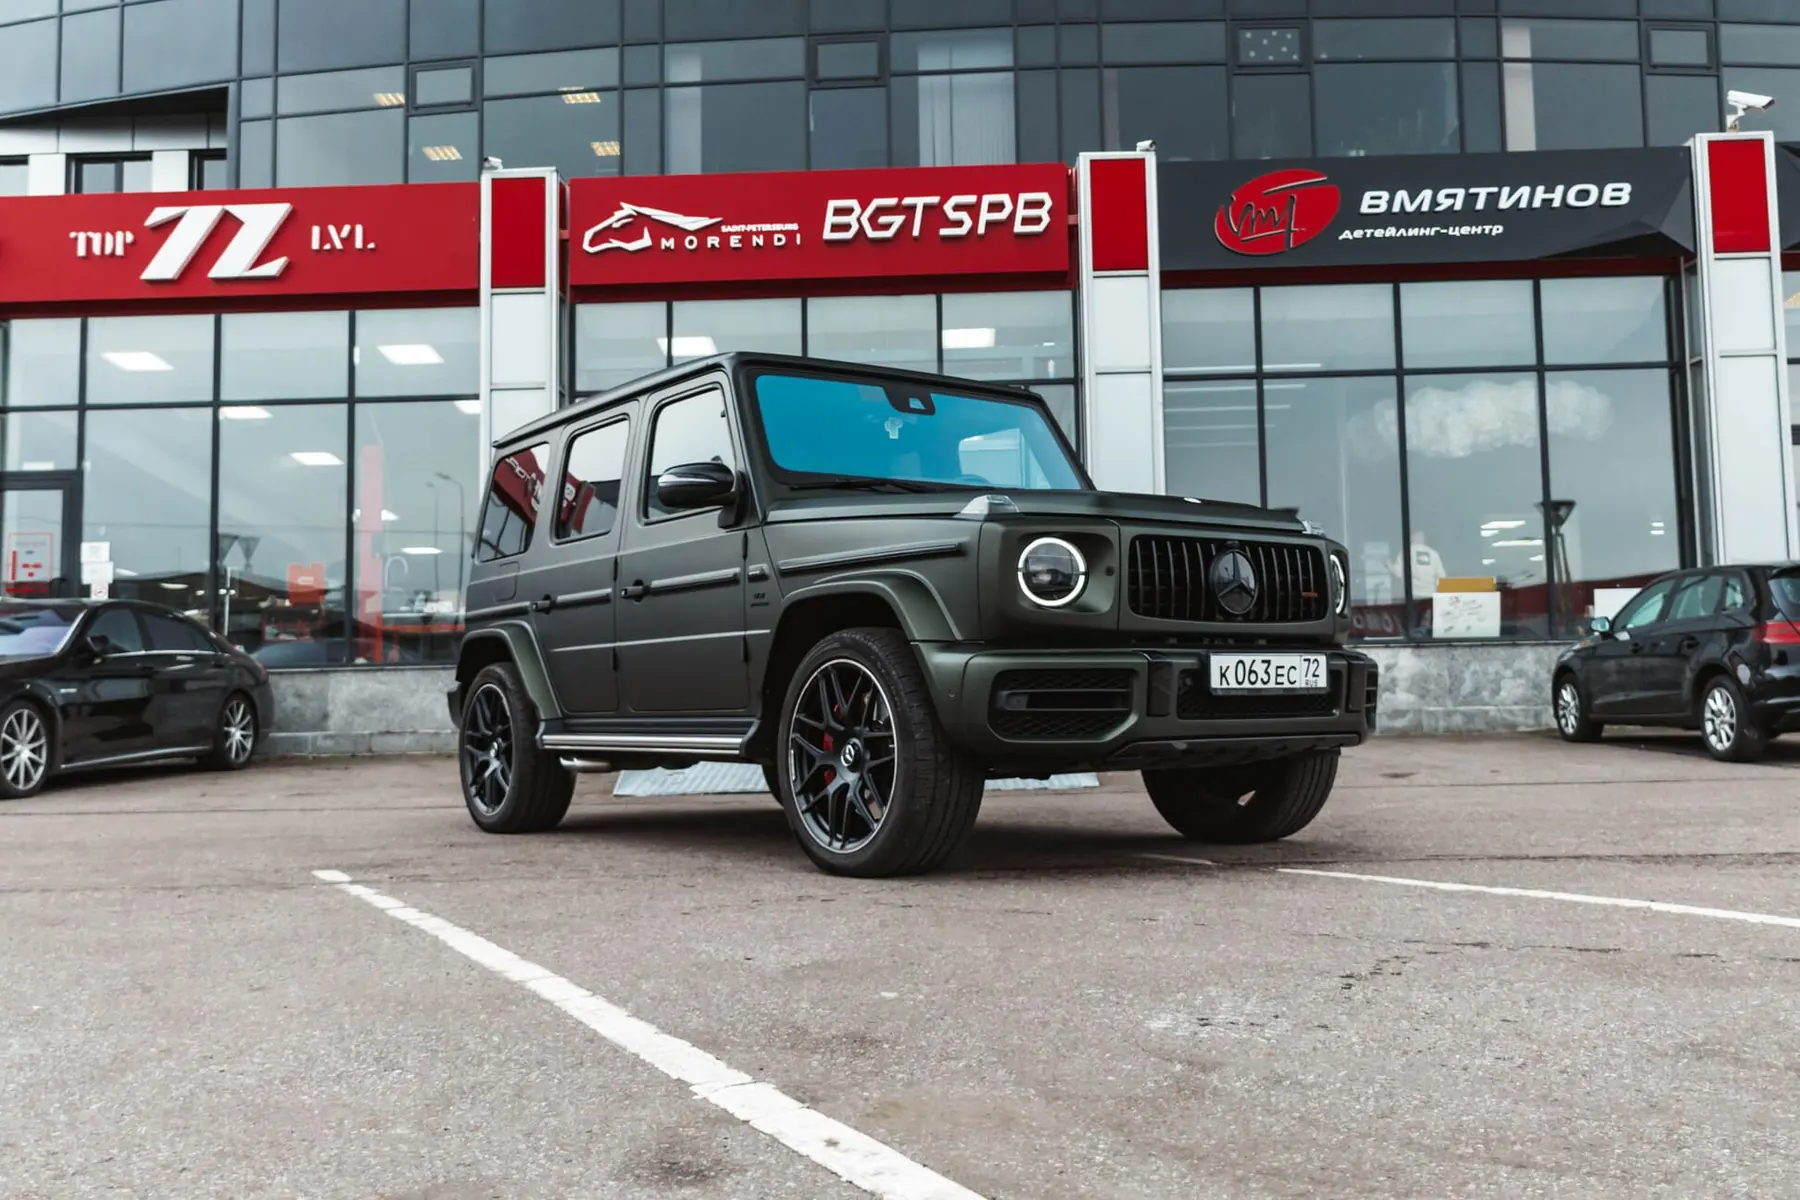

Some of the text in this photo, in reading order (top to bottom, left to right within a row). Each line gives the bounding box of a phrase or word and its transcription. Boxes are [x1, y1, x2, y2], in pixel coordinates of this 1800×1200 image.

[1359, 182, 1632, 215] ВМЯТИНОВ
[660, 232, 801, 250] MORENDI
[1338, 224, 1504, 240] детейлинг-центр
[69, 230, 135, 257] TOP
[1303, 658, 1320, 677] 72
